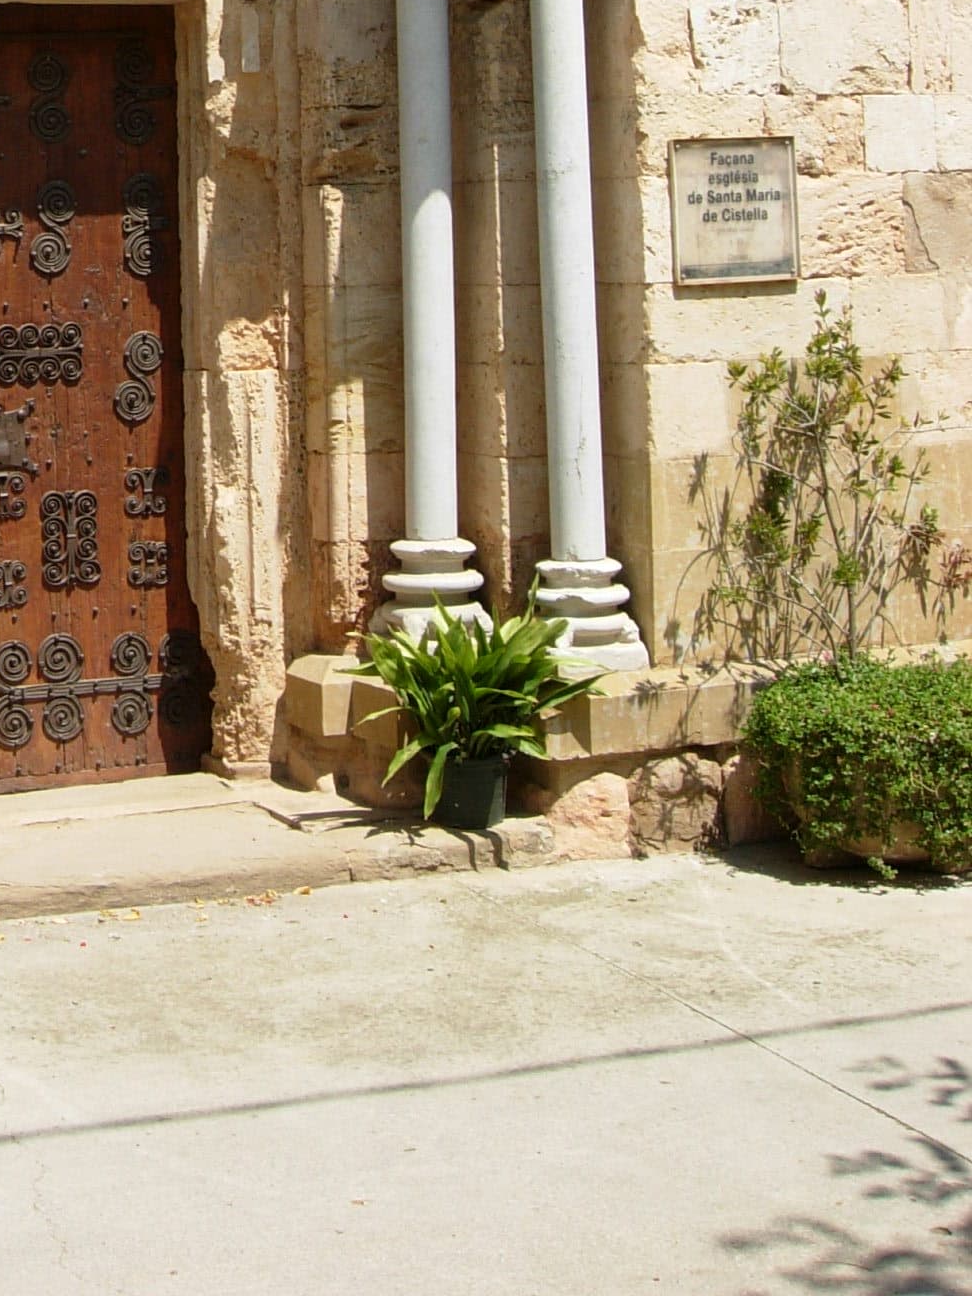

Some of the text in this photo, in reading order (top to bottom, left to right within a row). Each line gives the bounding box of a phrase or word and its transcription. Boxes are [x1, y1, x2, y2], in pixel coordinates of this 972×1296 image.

[710, 152, 755, 167] Façana
[708, 171, 759, 187] església
[688, 188, 781, 204] de Santa Maria
[702, 208, 768, 222] de Cistella
